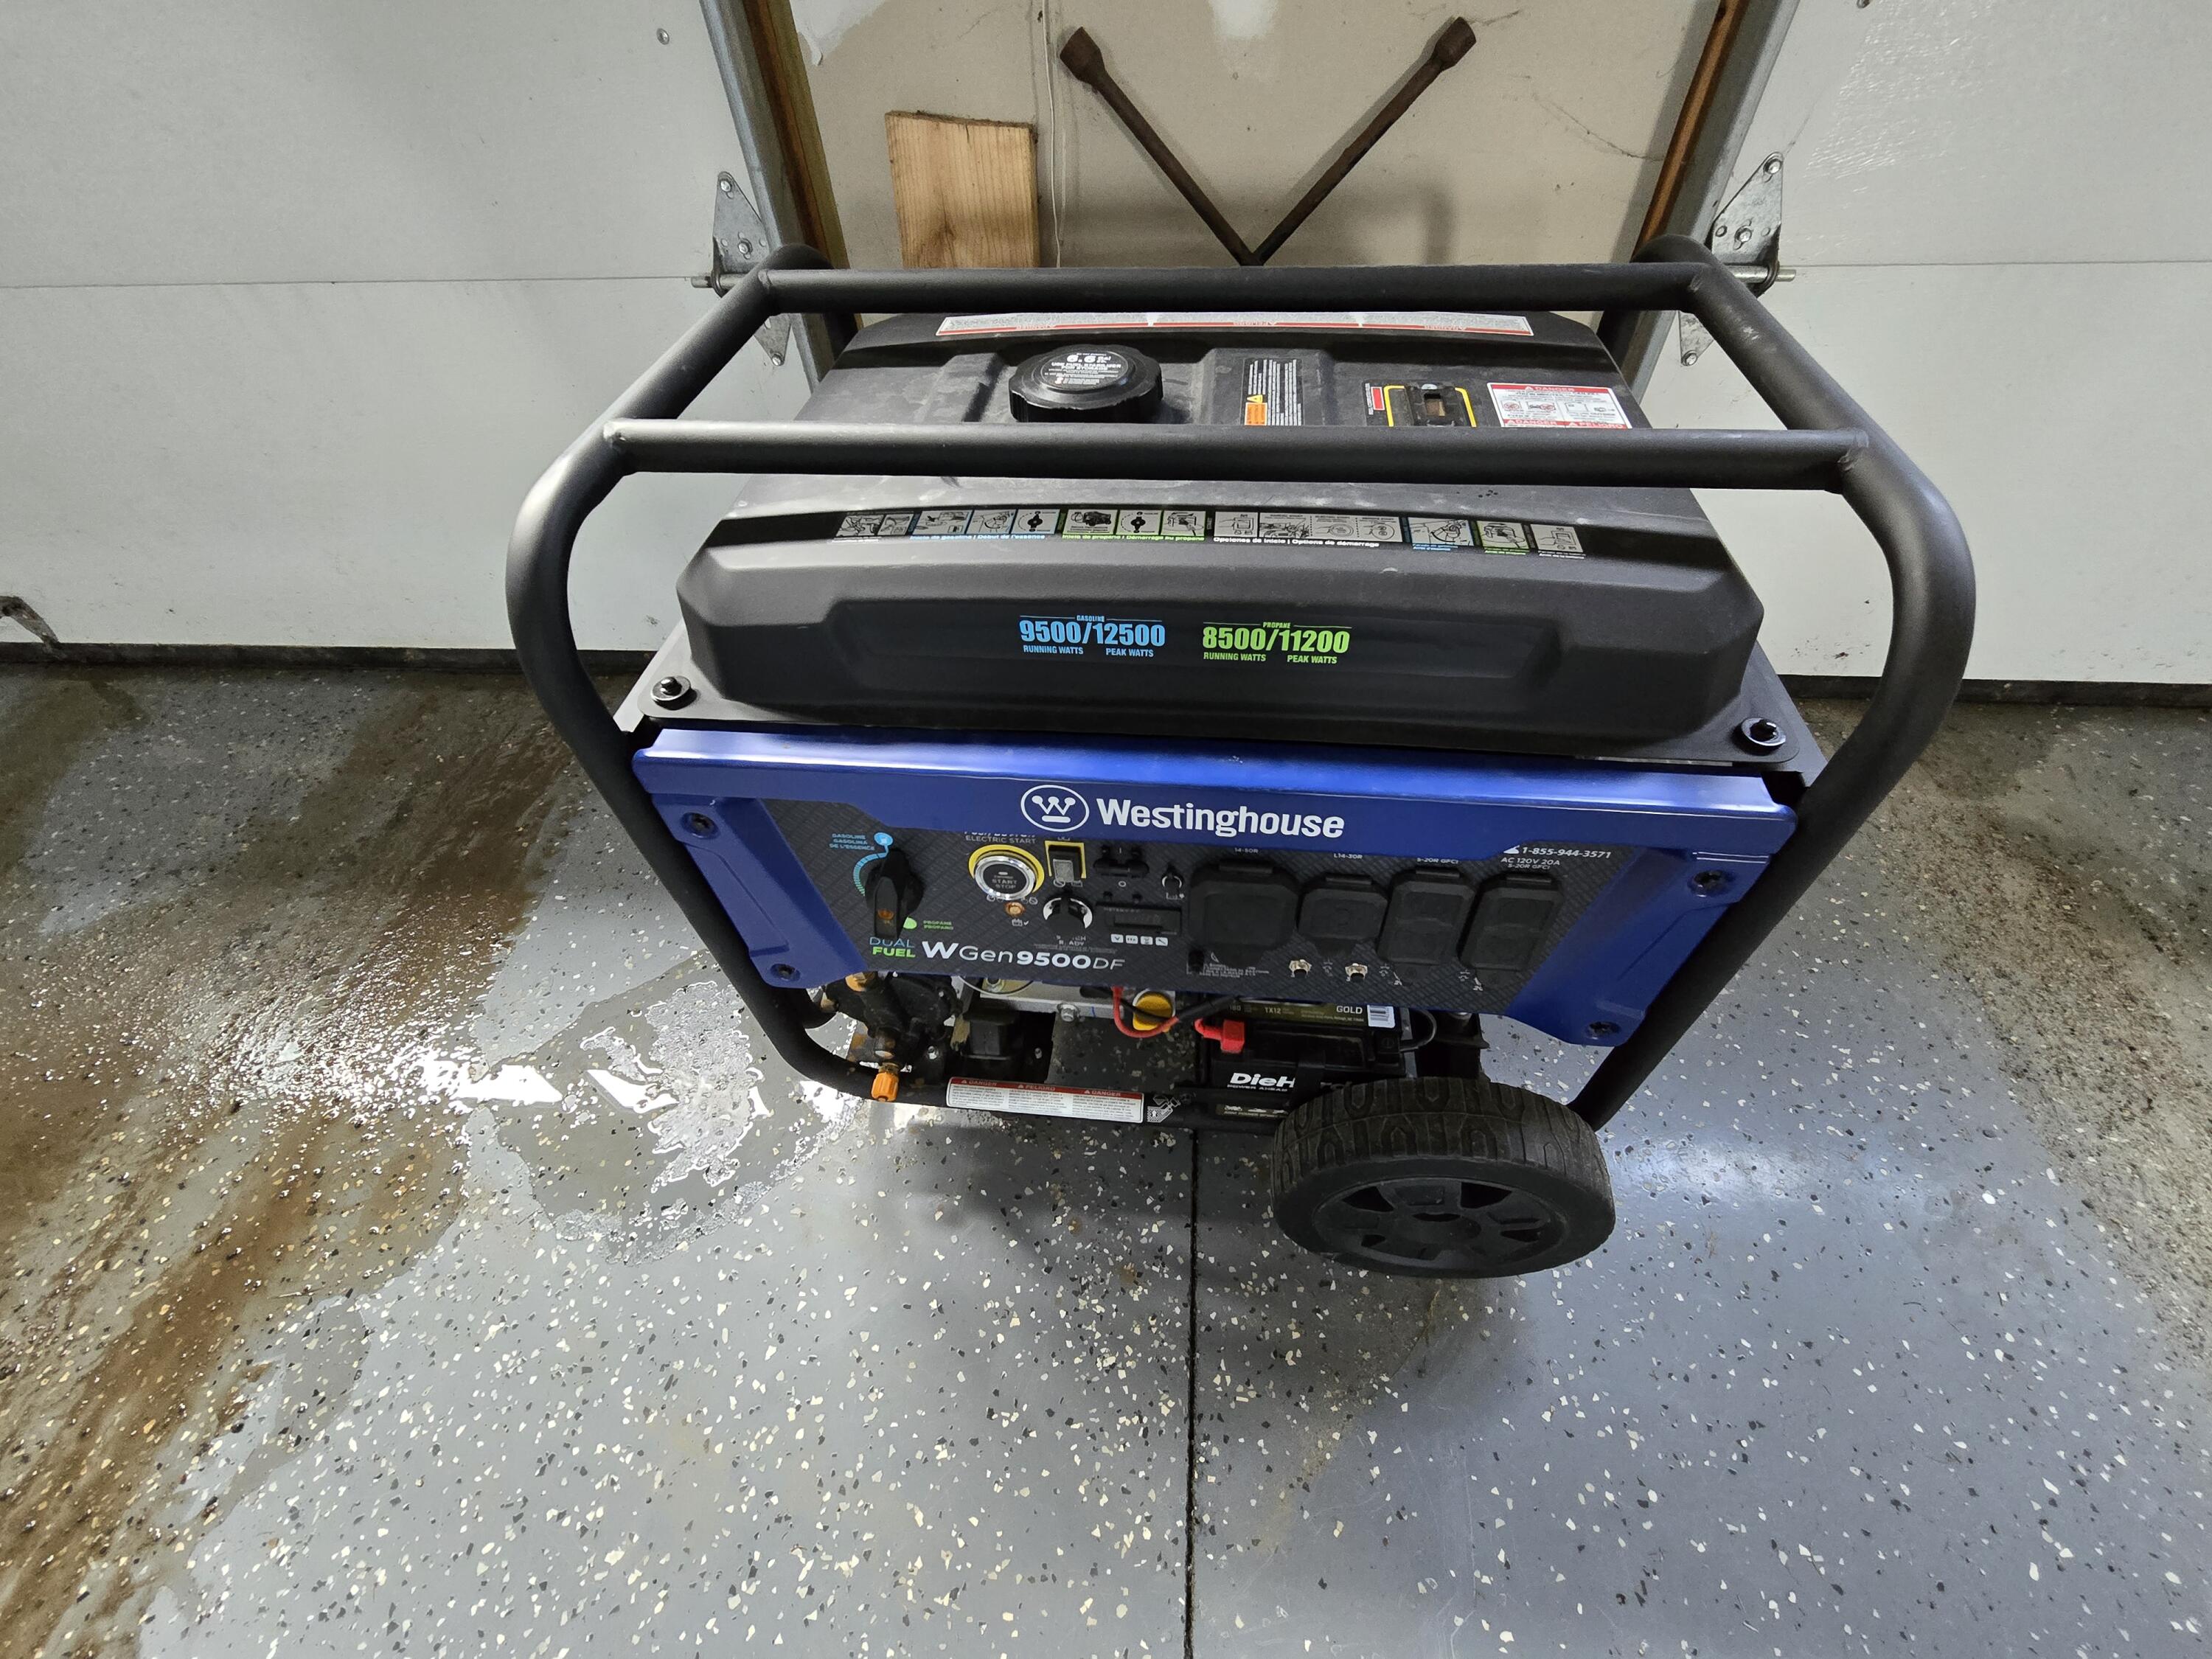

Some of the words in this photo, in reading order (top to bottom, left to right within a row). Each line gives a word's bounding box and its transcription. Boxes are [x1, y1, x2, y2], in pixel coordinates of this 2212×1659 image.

[1019, 620, 1166, 647] 9500/12500
[1203, 627, 1351, 653] 8500/11200
[1023, 645, 1058, 655] RUNNING
[1059, 646, 1084, 655] WATTS
[1106, 648, 1126, 657] PEAK
[1127, 649, 1155, 658] WATTS
[1203, 653, 1239, 661] RUNNING
[1240, 653, 1266, 662] WATTS
[1287, 655, 1310, 663] PEAK
[1311, 655, 1337, 664] WATTS
[1096, 798, 1346, 838] Westinghouse
[965, 835, 1008, 844] ELECTRIC
[1522, 846, 1611, 859] 1-855-944-3571
[869, 936, 915, 948] DUAL
[872, 947, 916, 958] FUEL
[922, 941, 1125, 970] WGen9500DF
[1336, 1005, 1363, 1015] GOLD
[968, 1079, 997, 1087] DANGER
[1025, 1084, 1056, 1092] PELIGRO
